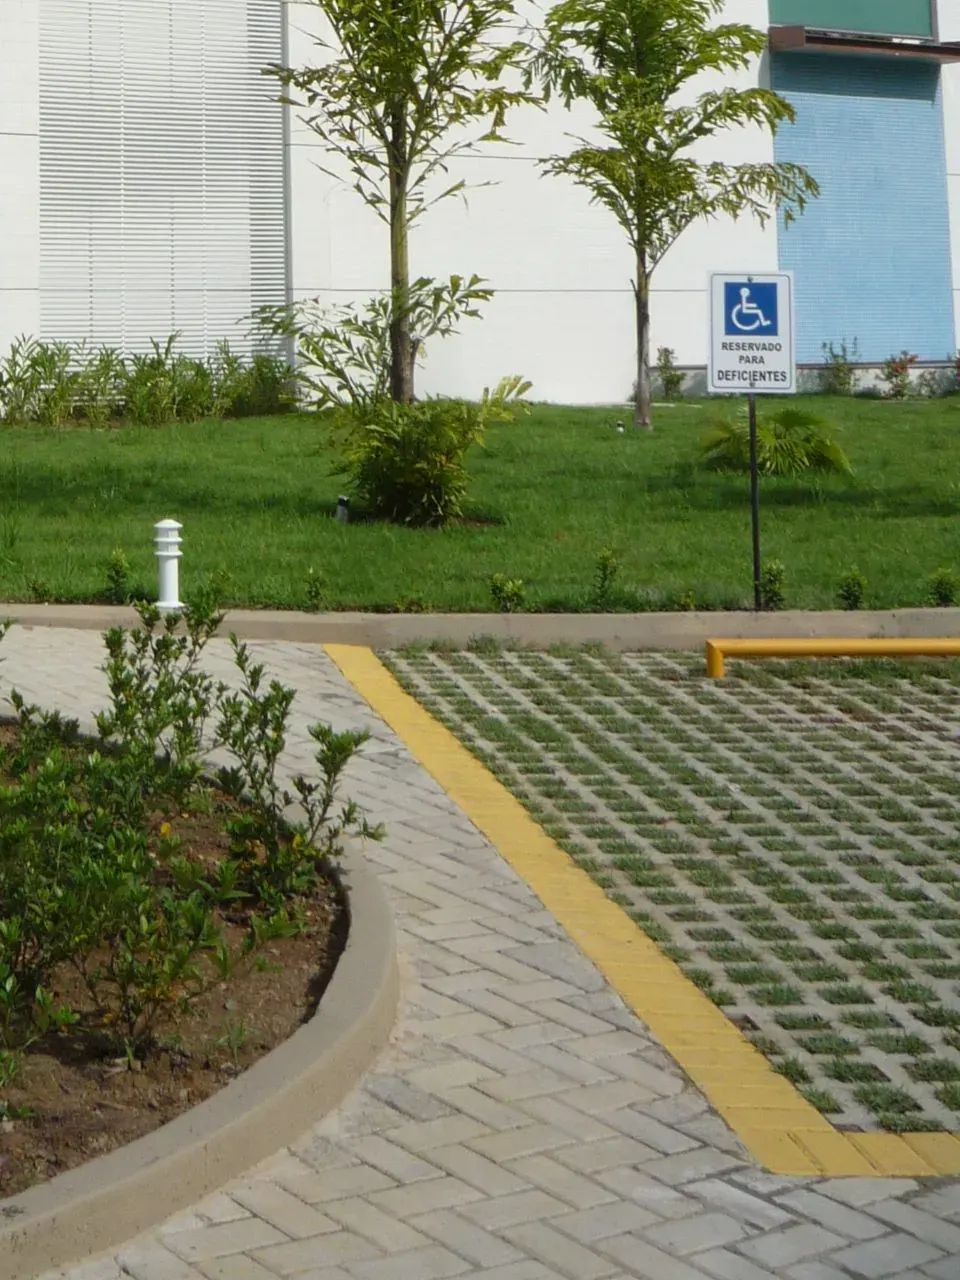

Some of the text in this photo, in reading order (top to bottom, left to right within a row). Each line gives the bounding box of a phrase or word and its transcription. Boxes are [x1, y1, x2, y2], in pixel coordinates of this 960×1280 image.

[721, 342, 782, 352] RESERVADO
[738, 355, 765, 365] PARA
[717, 370, 787, 382] DEFICIENTES
